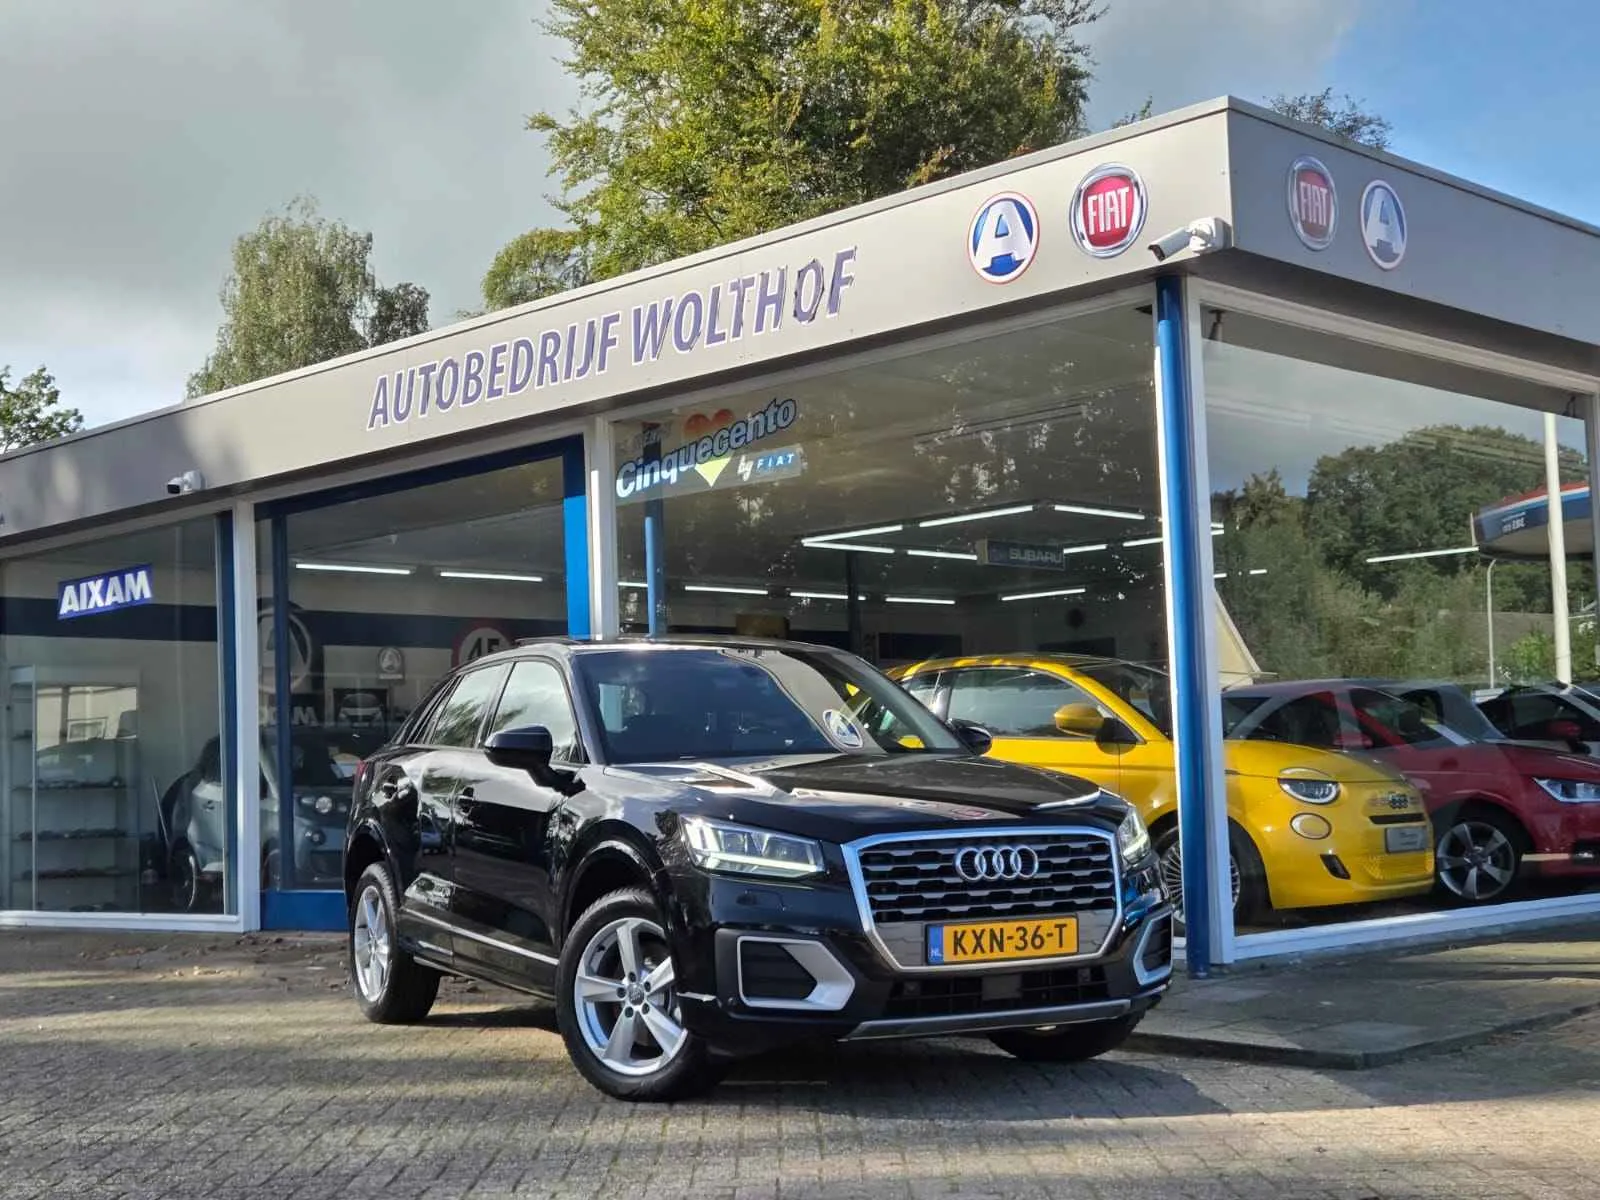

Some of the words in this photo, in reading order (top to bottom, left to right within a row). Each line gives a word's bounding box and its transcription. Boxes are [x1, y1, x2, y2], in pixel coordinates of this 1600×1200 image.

[1087, 186, 1130, 236] FIAT
[1299, 181, 1328, 227] FIAT
[367, 311, 621, 430] AUTOBEDRIJF
[632, 245, 858, 365] WOLTHOF
[616, 398, 797, 498] Cinquecento
[737, 454, 754, 482] by
[756, 452, 795, 471] FIAT
[1009, 547, 1062, 563] SUBARU
[60, 570, 152, 615] AIXAM
[952, 923, 1068, 956] KXN-36-T
